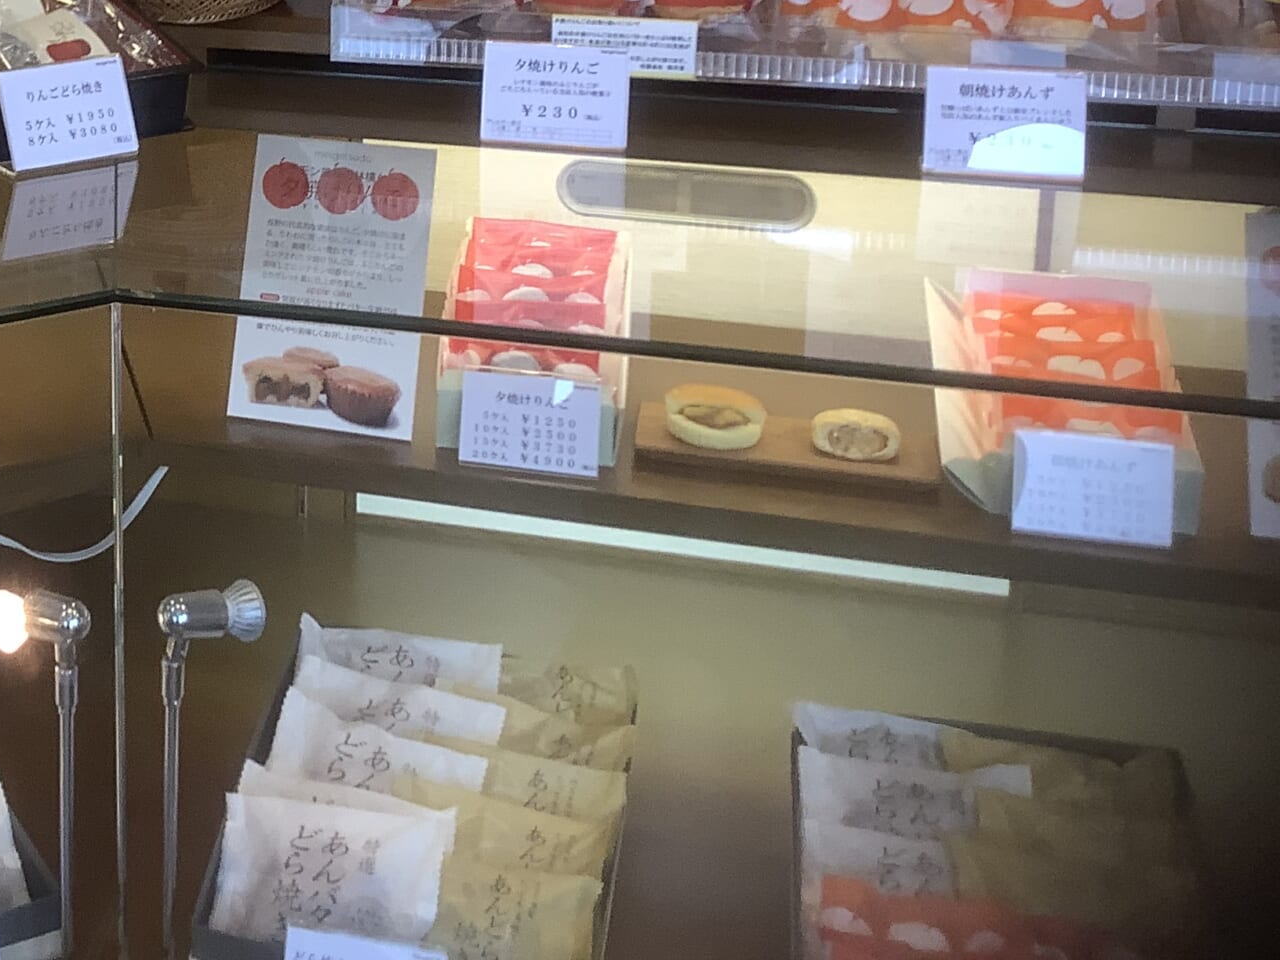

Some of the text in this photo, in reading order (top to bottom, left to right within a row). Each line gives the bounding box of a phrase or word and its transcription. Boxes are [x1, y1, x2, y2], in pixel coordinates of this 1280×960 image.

[514, 58, 600, 75] 夕焼けりんご
[25, 81, 104, 103] りんごどら焼き
[959, 82, 1055, 101] 朝焼けあんず
[25, 107, 116, 132] 5ケ入 ¥1950
[521, 103, 579, 120] ¥230
[27, 122, 119, 147] 8ケ入 ¥3080
[309, 831, 350, 924] あんバタ
